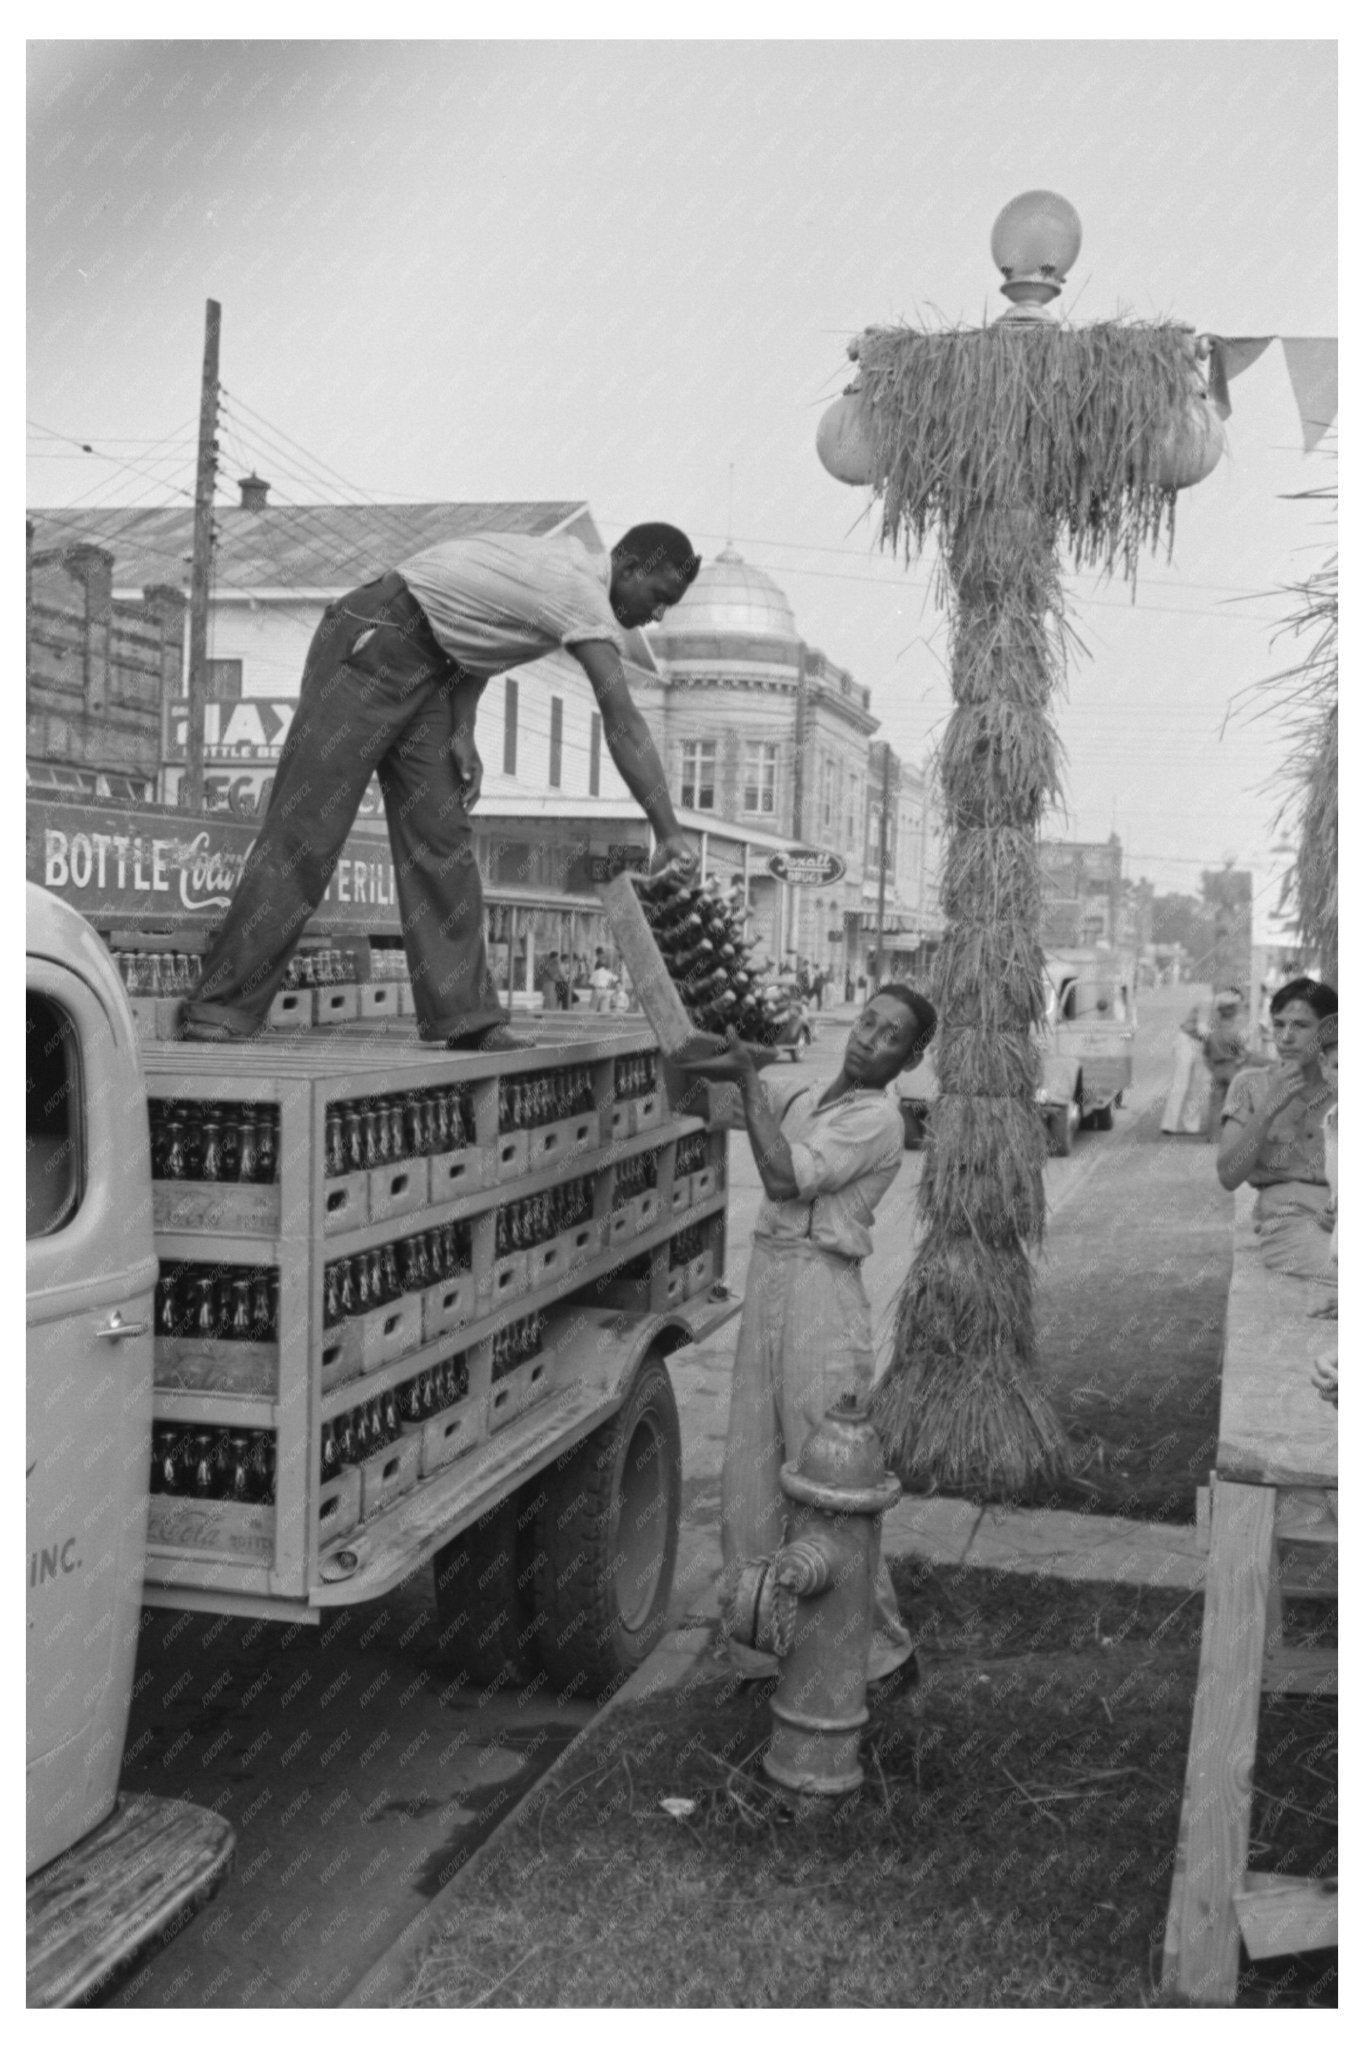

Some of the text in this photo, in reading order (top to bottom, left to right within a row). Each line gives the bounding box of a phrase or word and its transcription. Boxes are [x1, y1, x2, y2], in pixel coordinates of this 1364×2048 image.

[44, 828, 169, 891] BOTTLE
[323, 859, 395, 905] ERILI
[776, 852, 832, 873] Rexall
[30, 1536, 83, 1588] INC.
